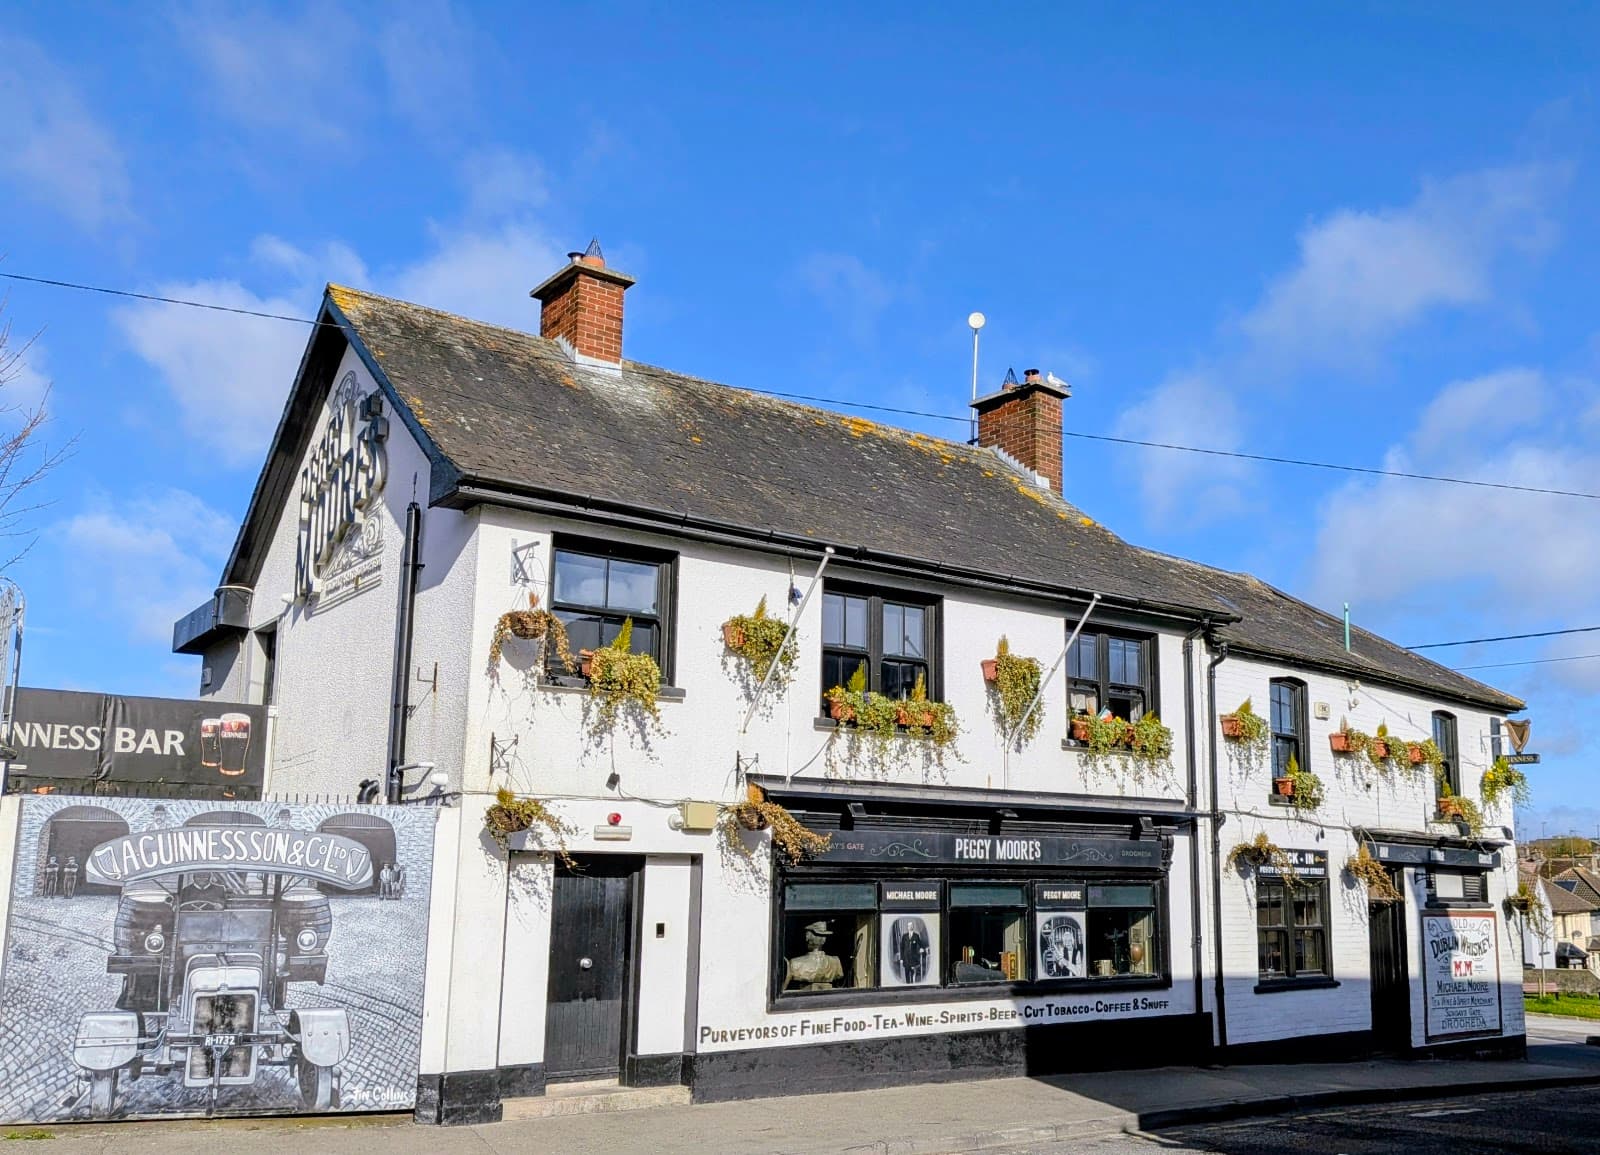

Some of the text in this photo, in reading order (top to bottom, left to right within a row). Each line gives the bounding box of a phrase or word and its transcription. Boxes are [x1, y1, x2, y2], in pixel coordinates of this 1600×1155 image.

[114, 727, 186, 756] BAR
[846, 842, 865, 850] GATE
[955, 838, 991, 860] PEGGY
[886, 891, 937, 900] MICHAEL MOORE
[1043, 891, 1082, 900] PEGGY MOORE
[1454, 918, 1467, 928] OLD
[1430, 935, 1459, 959] DUBLIN
[1437, 979, 1489, 993] MICHAEL MOORE
[700, 1026, 778, 1043] PURVEYORS
[781, 1025, 797, 1037] OF
[800, 1020, 831, 1036] FINE
[1141, 998, 1169, 1010] SNUFF
